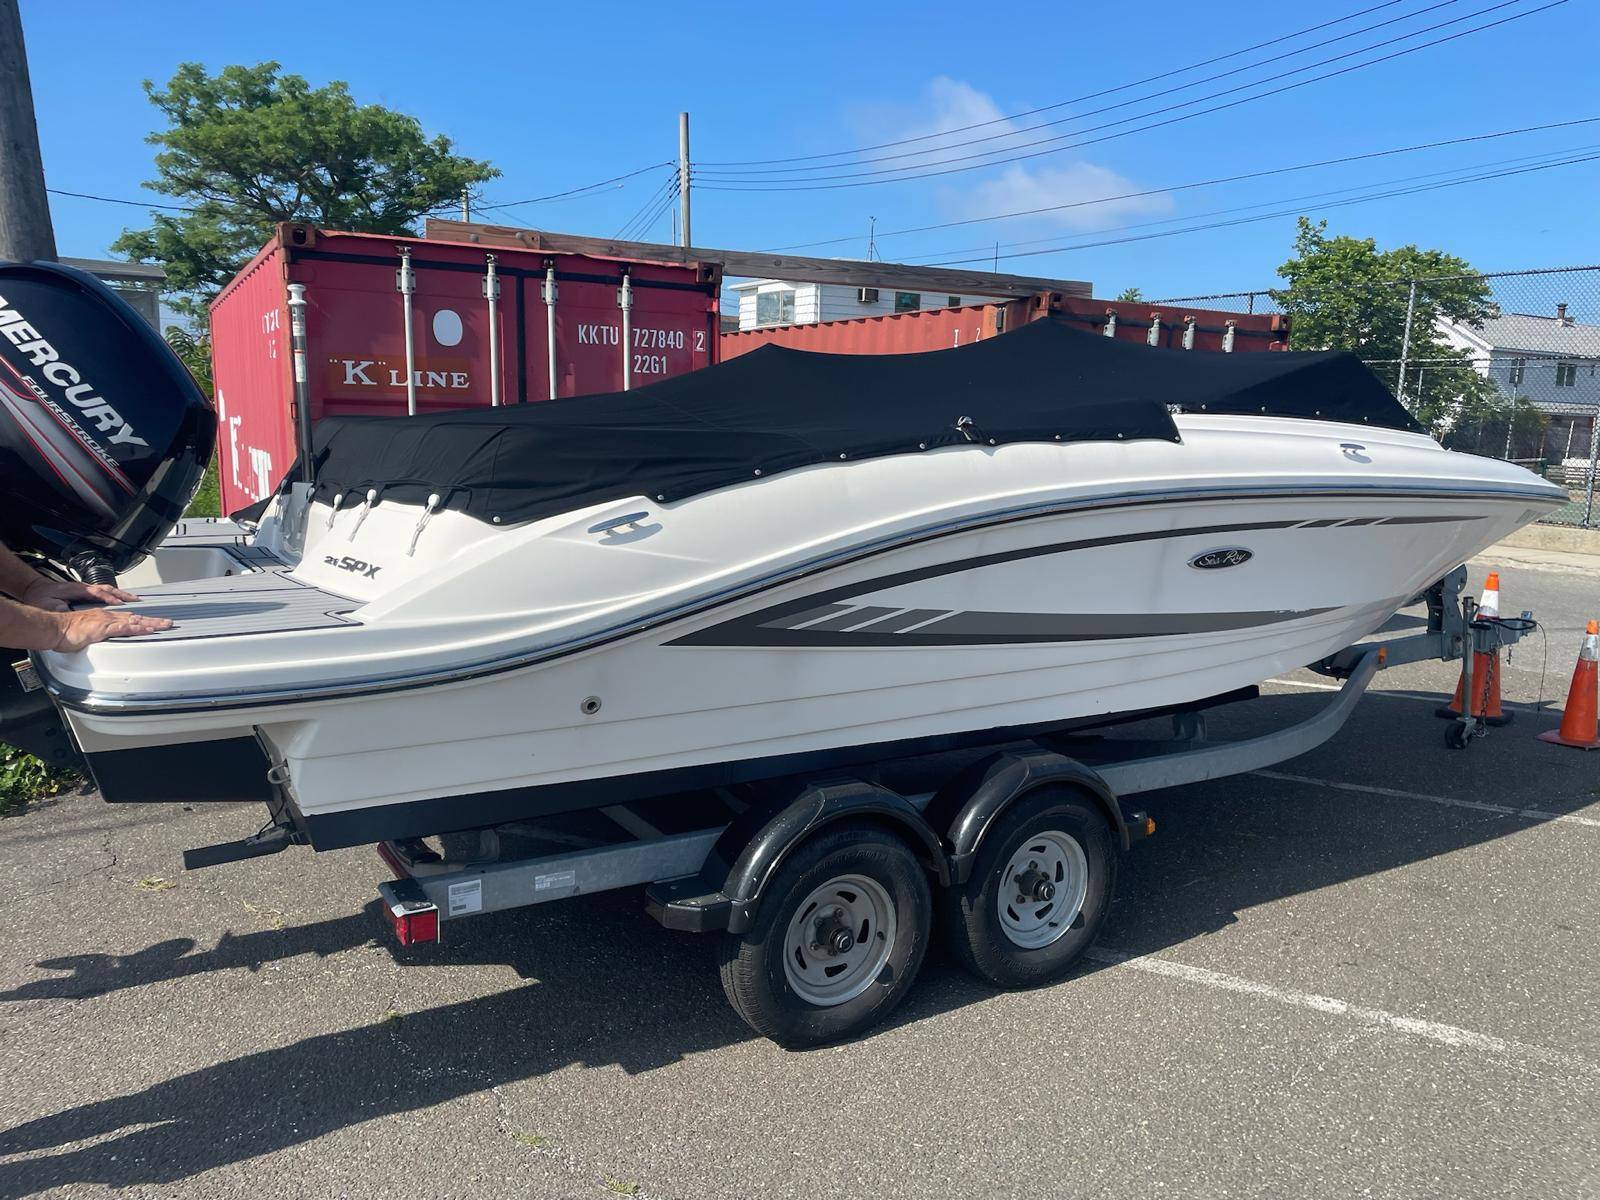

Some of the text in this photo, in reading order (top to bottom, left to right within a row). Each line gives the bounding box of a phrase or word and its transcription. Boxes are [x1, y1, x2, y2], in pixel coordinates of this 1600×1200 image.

[578, 324, 704, 350] KKTU 727840 2
[633, 354, 667, 374] 22G1
[388, 369, 470, 388] LINE
[21, 375, 120, 468] FOURSTROKE
[338, 556, 382, 580] SPX
